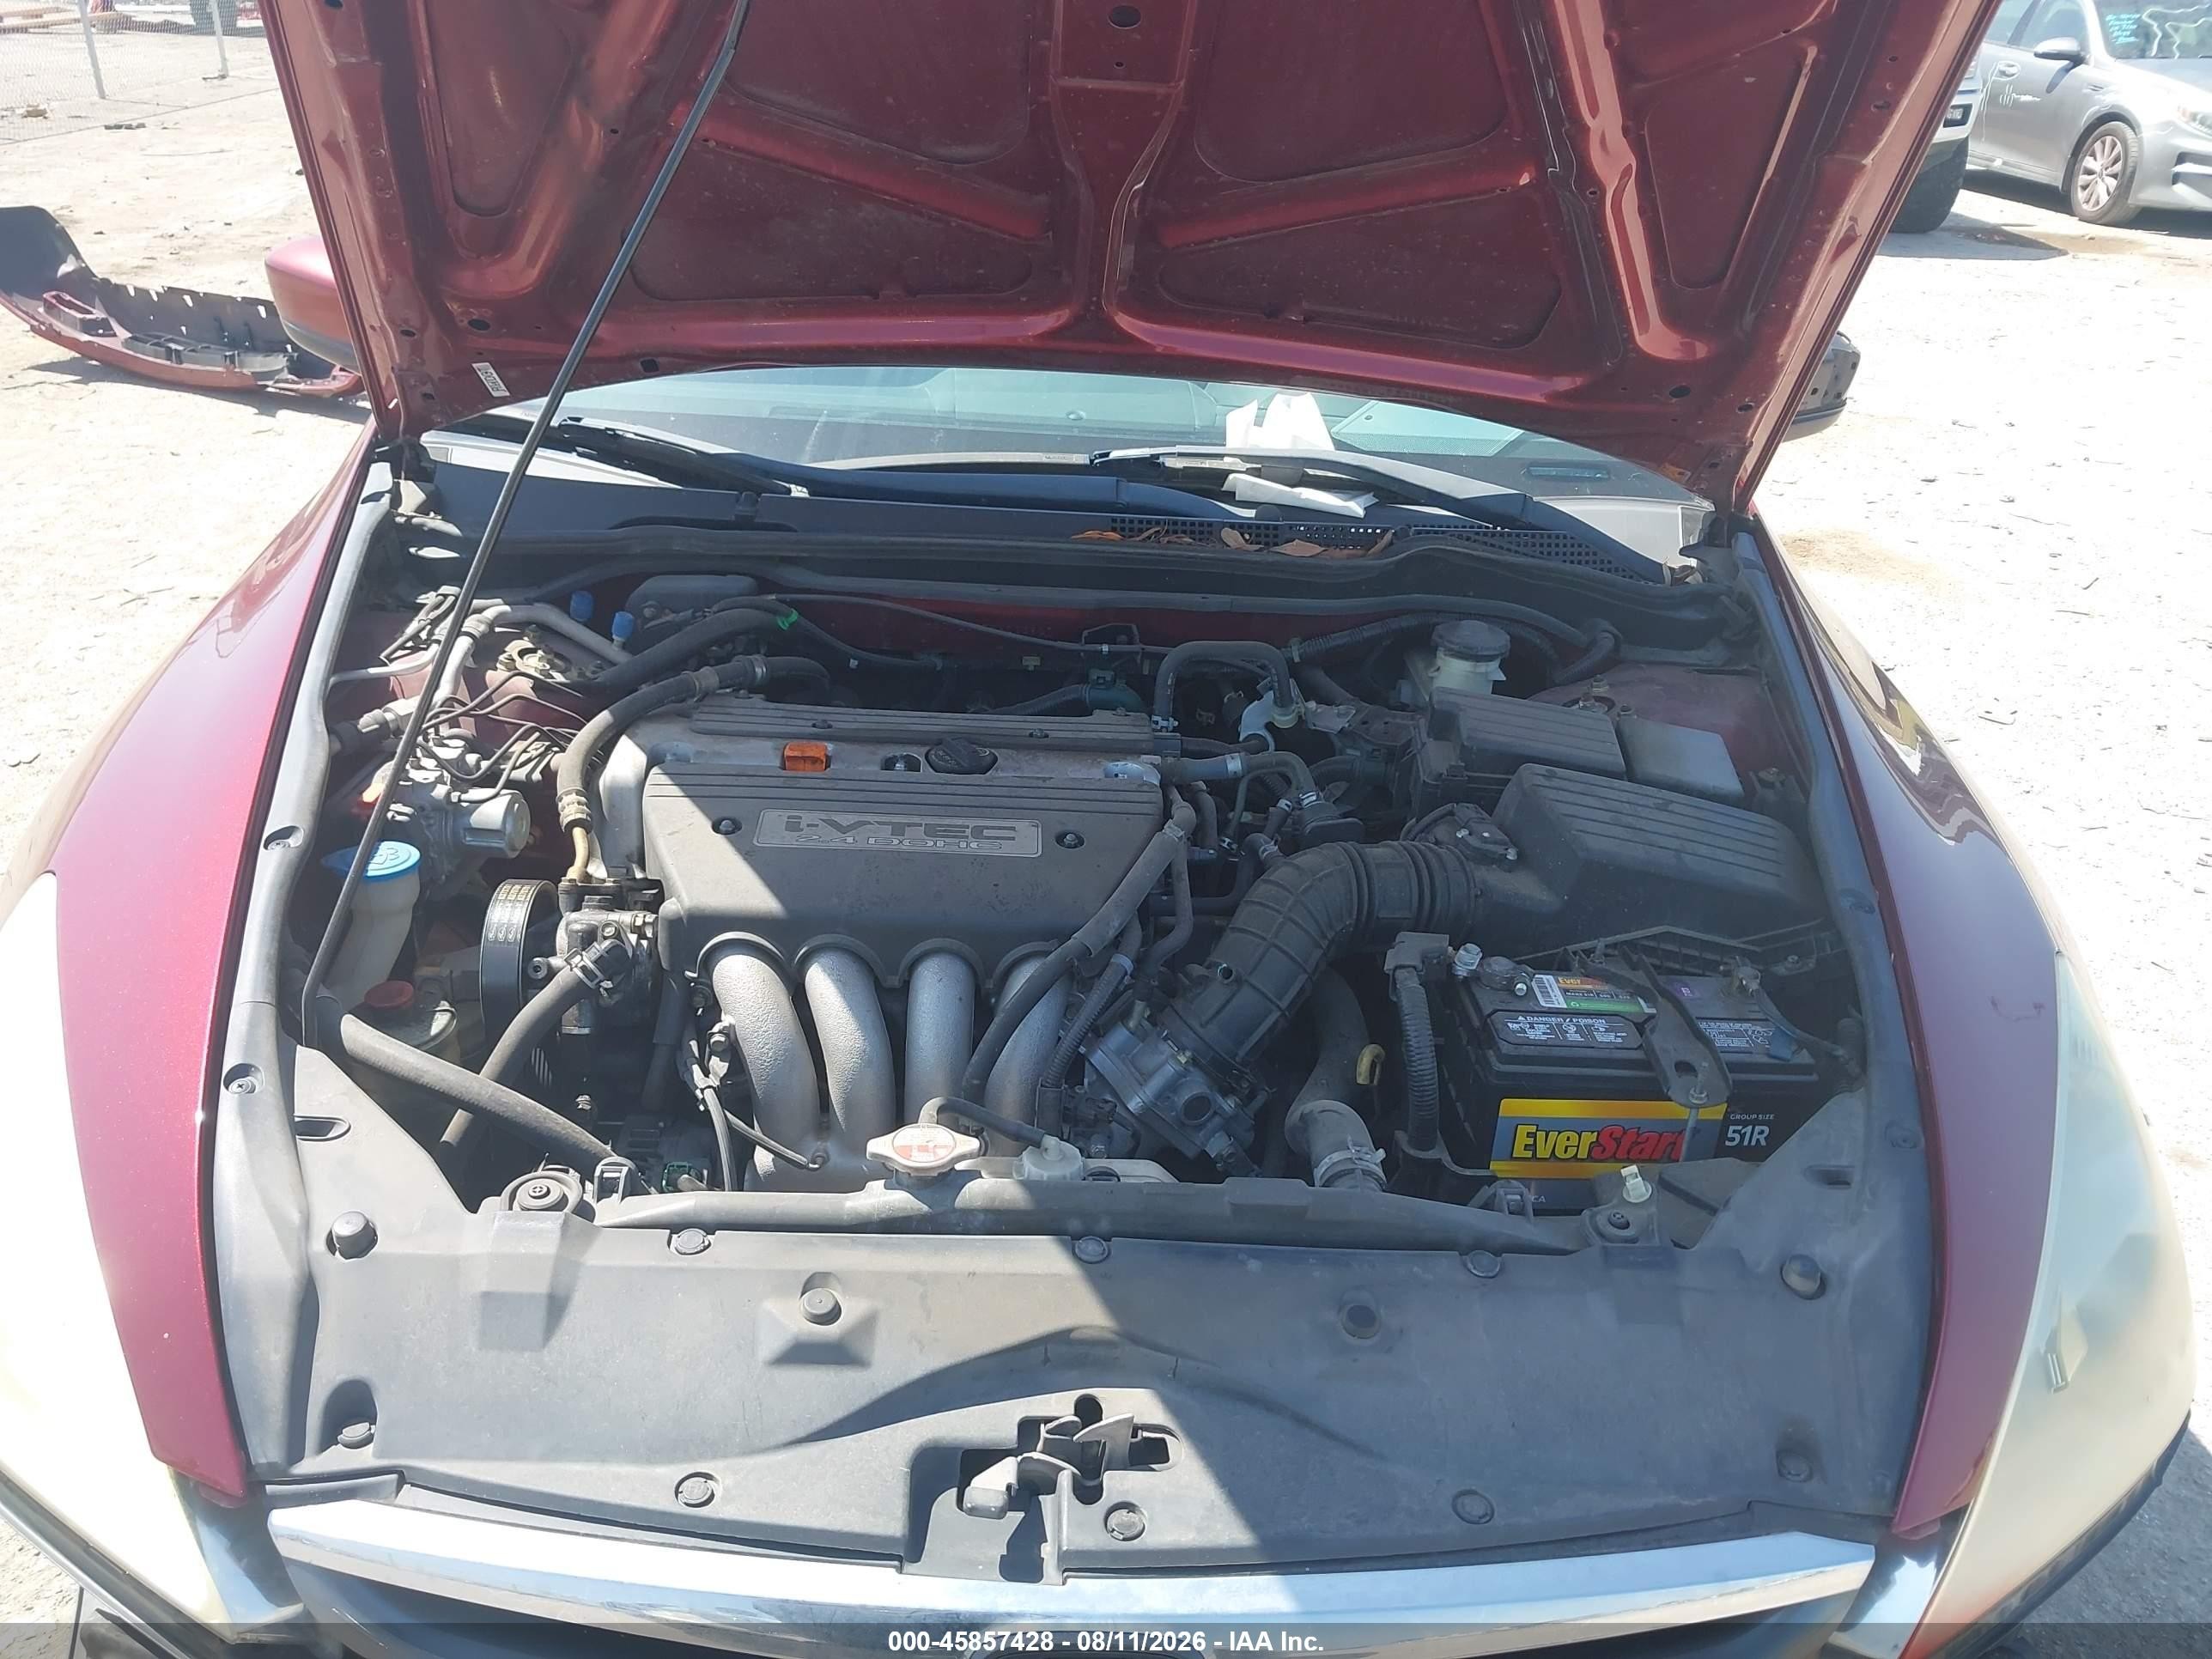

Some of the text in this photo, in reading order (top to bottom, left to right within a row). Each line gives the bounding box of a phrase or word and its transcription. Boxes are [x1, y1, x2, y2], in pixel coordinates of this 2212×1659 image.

[785, 815, 1017, 842] i-VTEC
[867, 837, 1003, 850] DOHC
[1724, 1125, 1770, 1147] 51R
